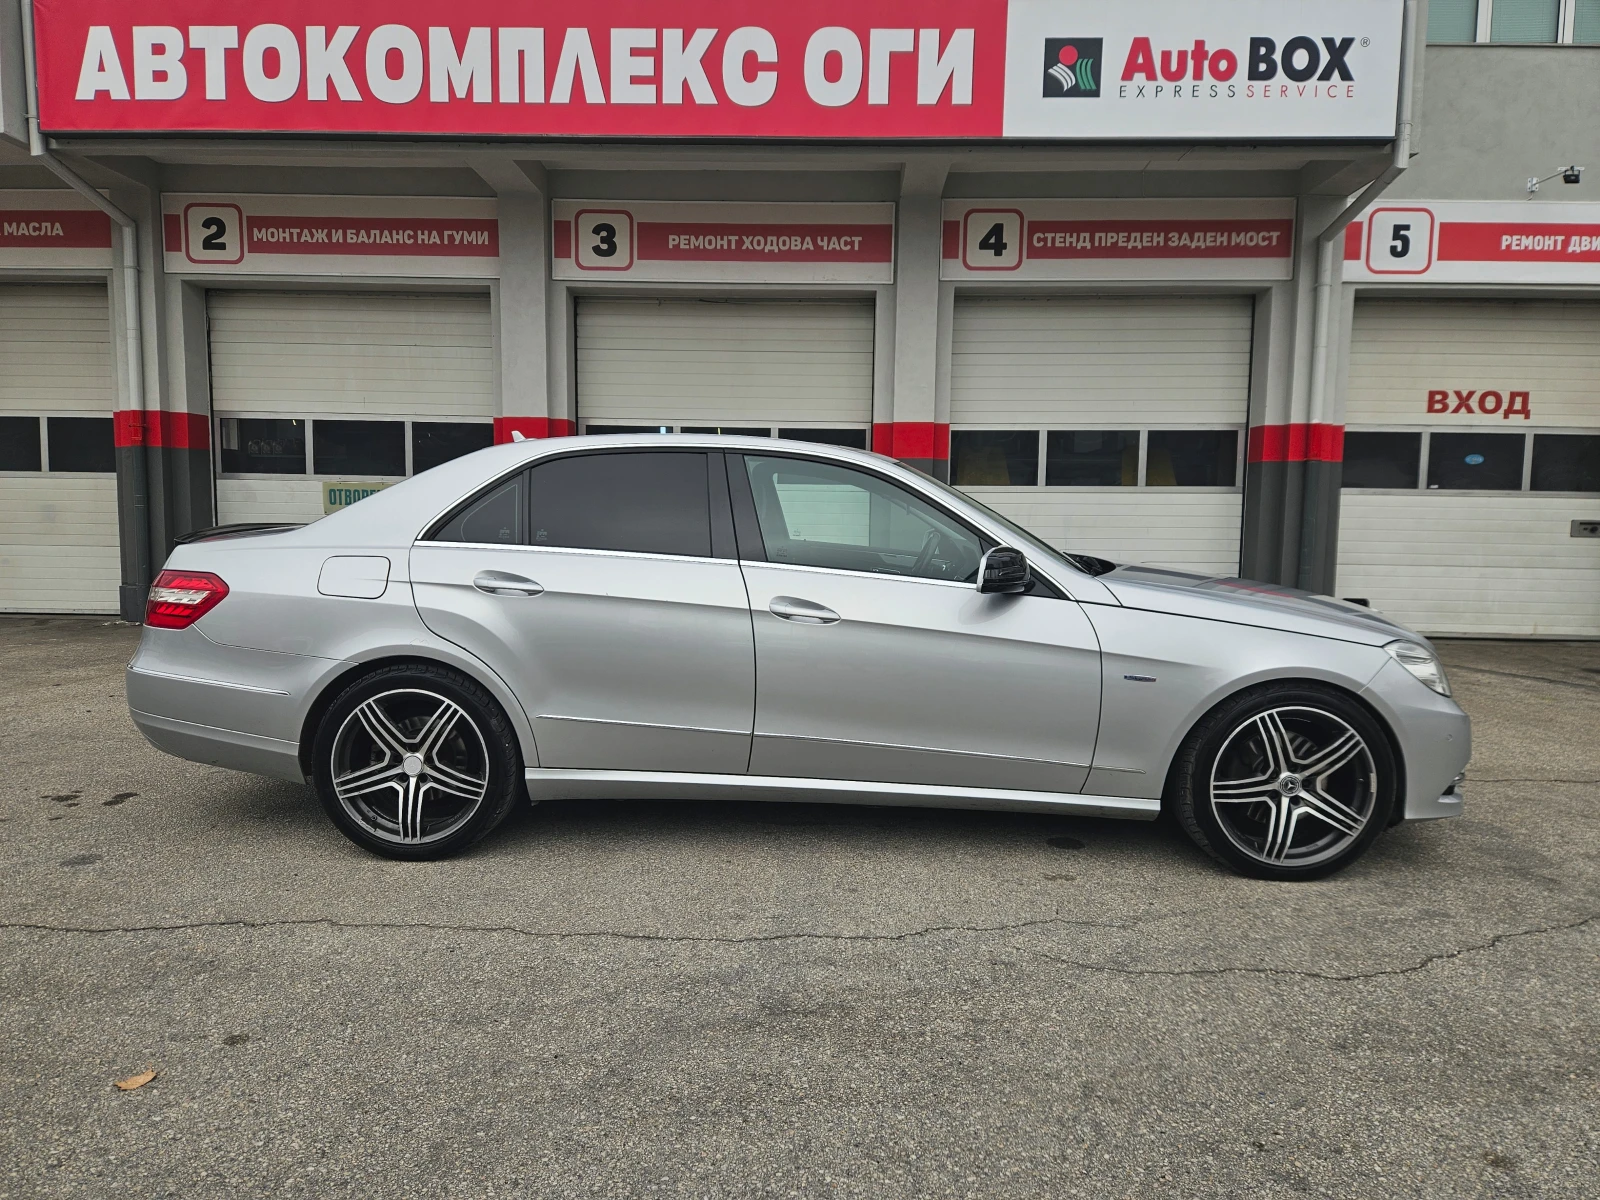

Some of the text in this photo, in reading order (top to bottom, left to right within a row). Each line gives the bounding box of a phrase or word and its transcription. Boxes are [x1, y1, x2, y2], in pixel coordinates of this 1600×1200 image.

[75, 23, 975, 107] АВТОКОМПЛЕКС ОГИ
[1120, 36, 1238, 82] Auto
[3, 221, 64, 237] МАСЛА
[201, 216, 227, 251] 2
[253, 227, 489, 245] МОНТАЖ И БАЛАНС НА ГУМИ
[591, 222, 618, 258] 3
[668, 234, 863, 253] РЕМОНТ ХОДОВА ЧАСТ
[978, 222, 1008, 257] 4
[1032, 231, 1281, 249] СТЕНД ПРЕДЕН ЗАДЕН МОСТ
[1389, 223, 1412, 258] 5
[1501, 234, 1566, 251] РЕМОНТ
[1426, 389, 1532, 420] ВХОД
